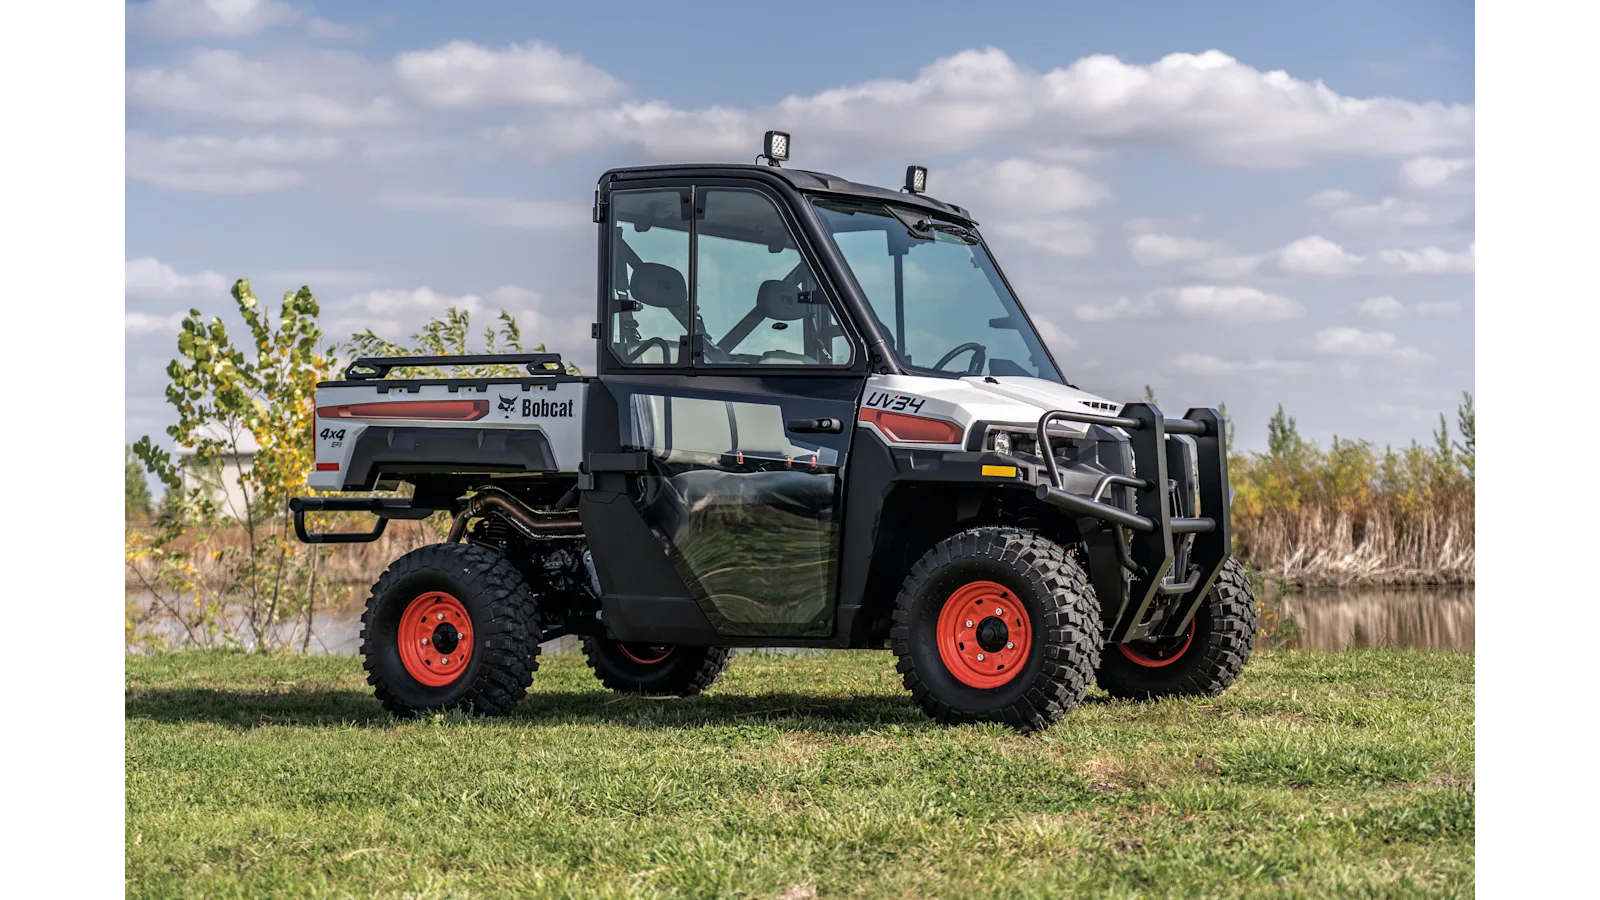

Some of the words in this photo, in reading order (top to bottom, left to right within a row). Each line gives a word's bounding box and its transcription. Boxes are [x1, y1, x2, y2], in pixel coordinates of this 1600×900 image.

[522, 398, 573, 418] Bobcat
[866, 391, 926, 413] UV34
[320, 428, 346, 441] 4x4
